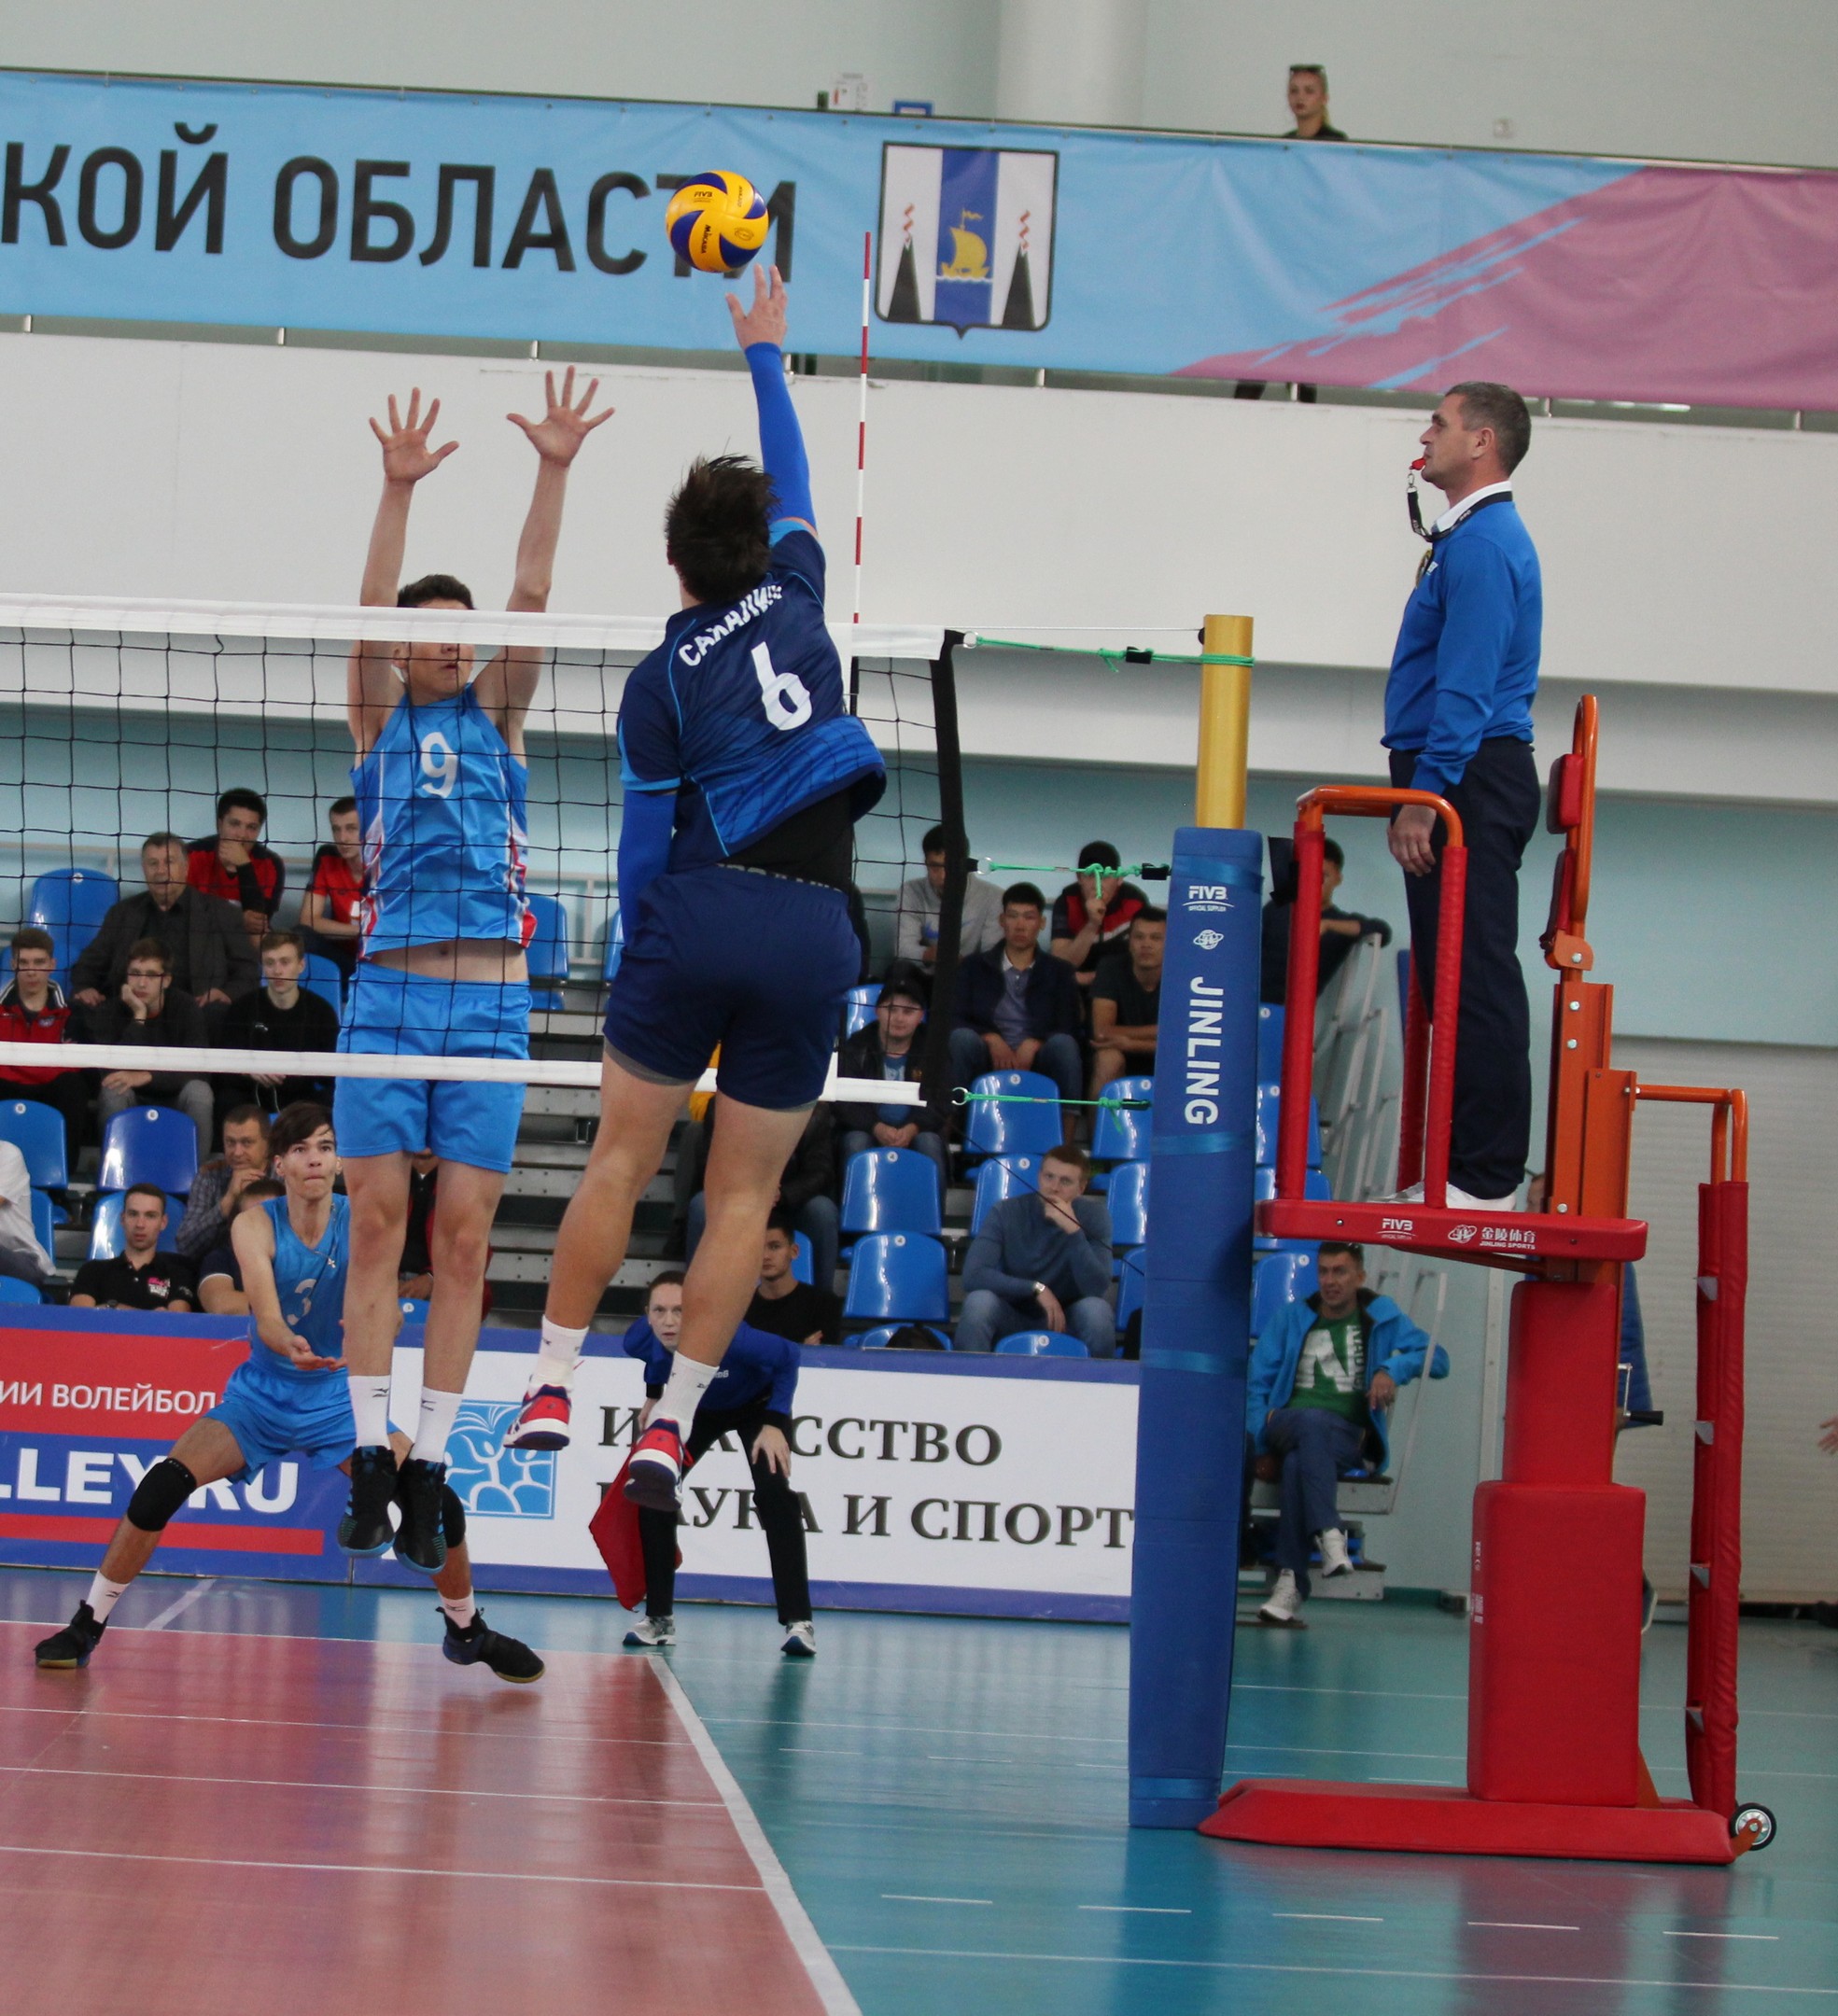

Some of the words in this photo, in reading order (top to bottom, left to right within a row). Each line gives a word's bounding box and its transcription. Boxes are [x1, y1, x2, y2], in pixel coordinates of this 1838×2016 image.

[3, 122, 229, 255] КОЙ
[751, 641, 812, 732] 6
[420, 732, 460, 798] 9
[1188, 886, 1228, 901] FIVB
[1185, 976, 1224, 1125] JINLING
[1382, 1218, 1413, 1231] FIVB
[52, 1383, 224, 1415] ВОЛЕЙБОЛ
[598, 1405, 1002, 1466] ИССТВО
[842, 1495, 892, 1537] И
[911, 1498, 1135, 1548] СПОРТ
